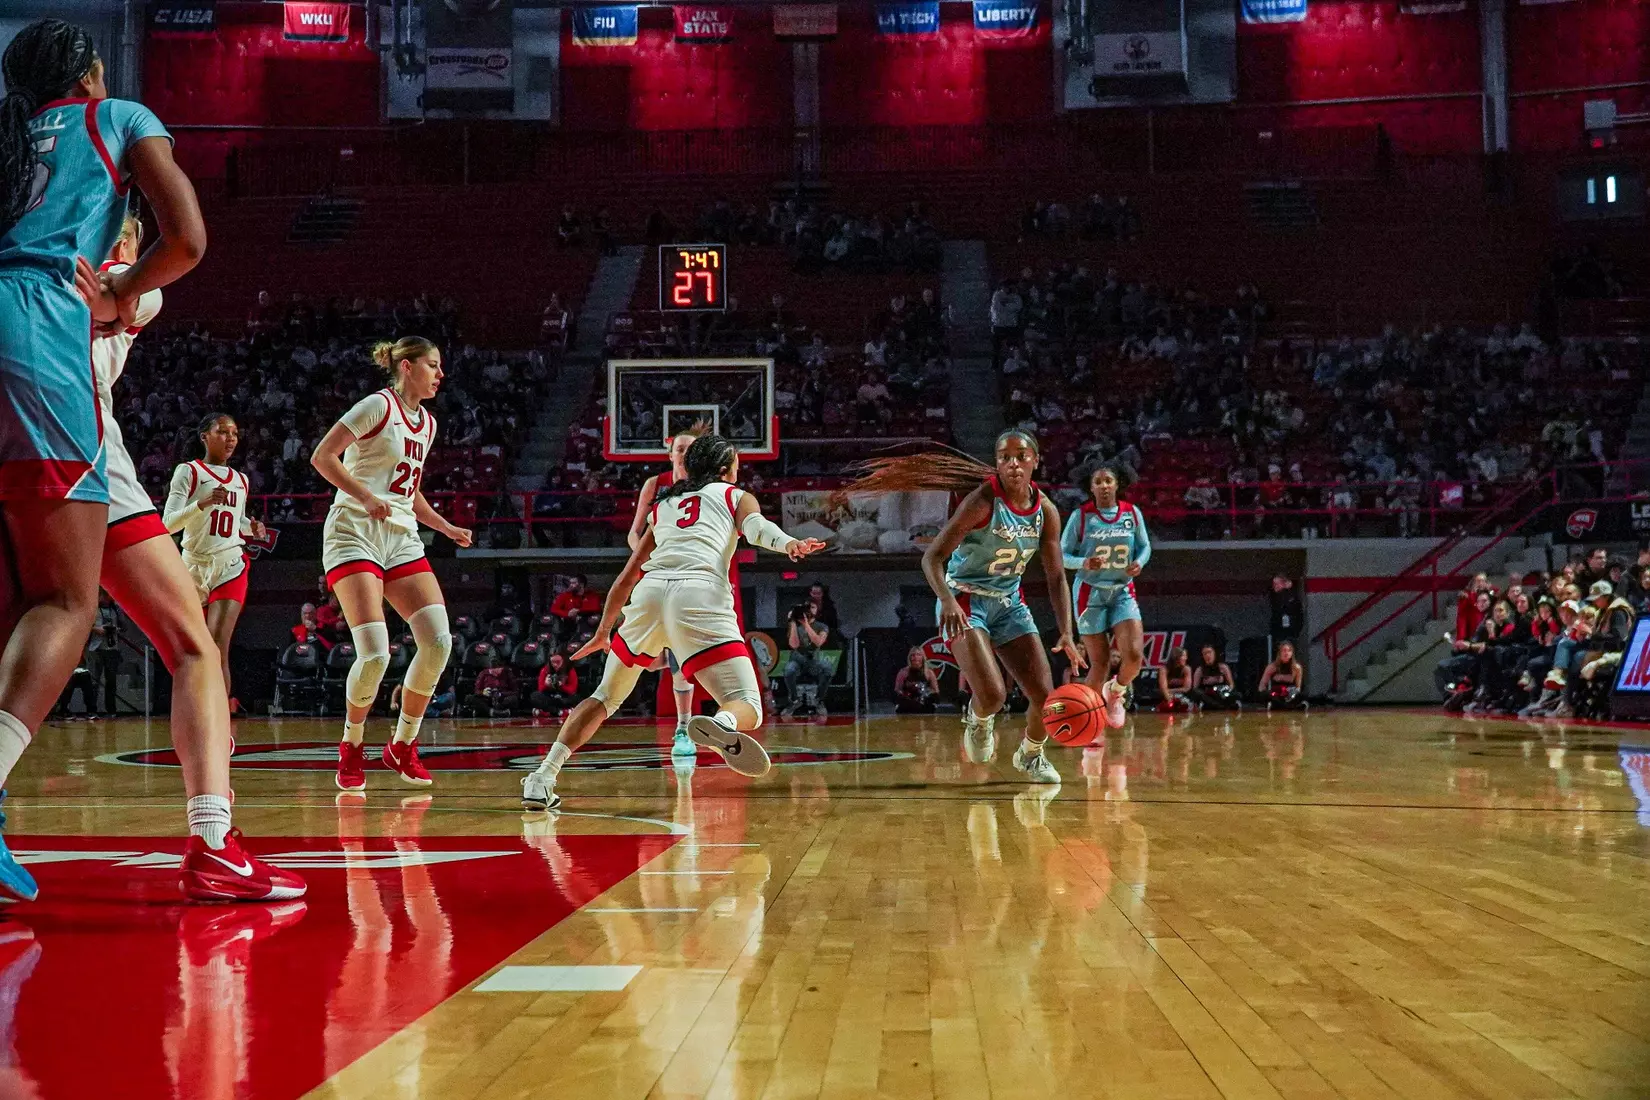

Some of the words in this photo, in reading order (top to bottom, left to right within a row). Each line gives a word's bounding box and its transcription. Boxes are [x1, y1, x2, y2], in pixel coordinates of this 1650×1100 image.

[300, 13, 333, 25] WKU
[593, 16, 616, 28] FIU
[691, 10, 718, 22] JAX
[978, 8, 1036, 22] LIBERTY
[683, 22, 728, 34] STATE
[679, 250, 719, 269] 7:47
[673, 271, 713, 304] 27
[404, 437, 423, 462] WKU
[389, 462, 421, 498] 23
[677, 495, 702, 529] 3
[210, 509, 233, 538] 10
[1095, 544, 1130, 569] 23
